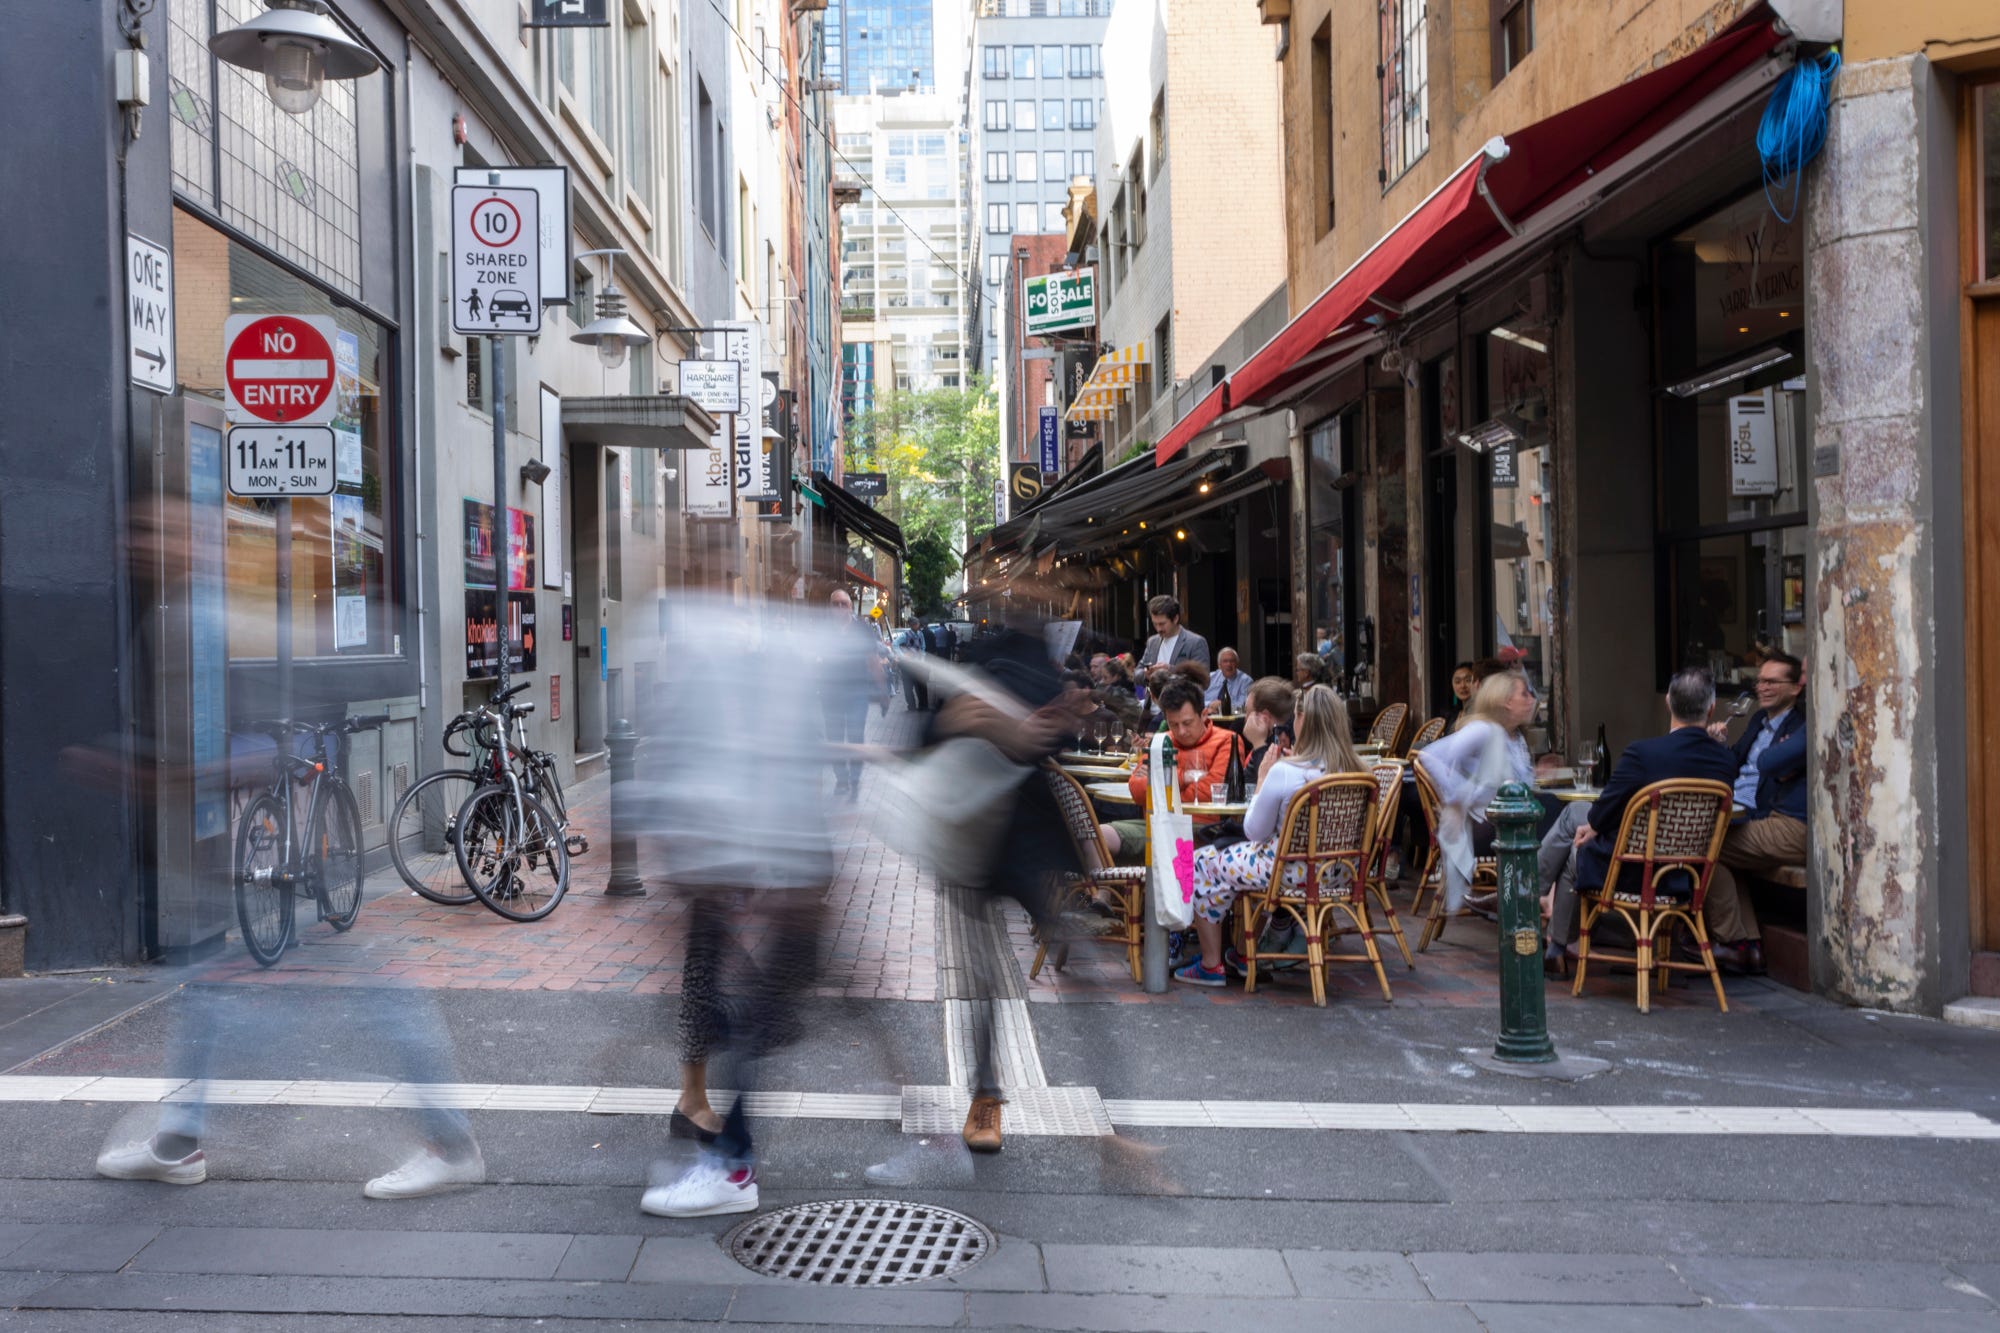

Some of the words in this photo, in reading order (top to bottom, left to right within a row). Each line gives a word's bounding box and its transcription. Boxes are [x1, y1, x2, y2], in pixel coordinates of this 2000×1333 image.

[484, 212, 507, 233] 10
[466, 252, 527, 267] SHARED
[133, 251, 164, 292] ONE
[477, 271, 517, 284] ZONE
[1029, 292, 1047, 309] FO
[1060, 285, 1091, 303] SALE
[1050, 280, 1059, 314] SOLD
[132, 294, 167, 337] WAY
[264, 333, 296, 353] NO
[686, 373, 735, 383] HARDWARE
[244, 385, 320, 405] ENTRY
[248, 476, 277, 487] MON
[290, 476, 317, 487] SUN
